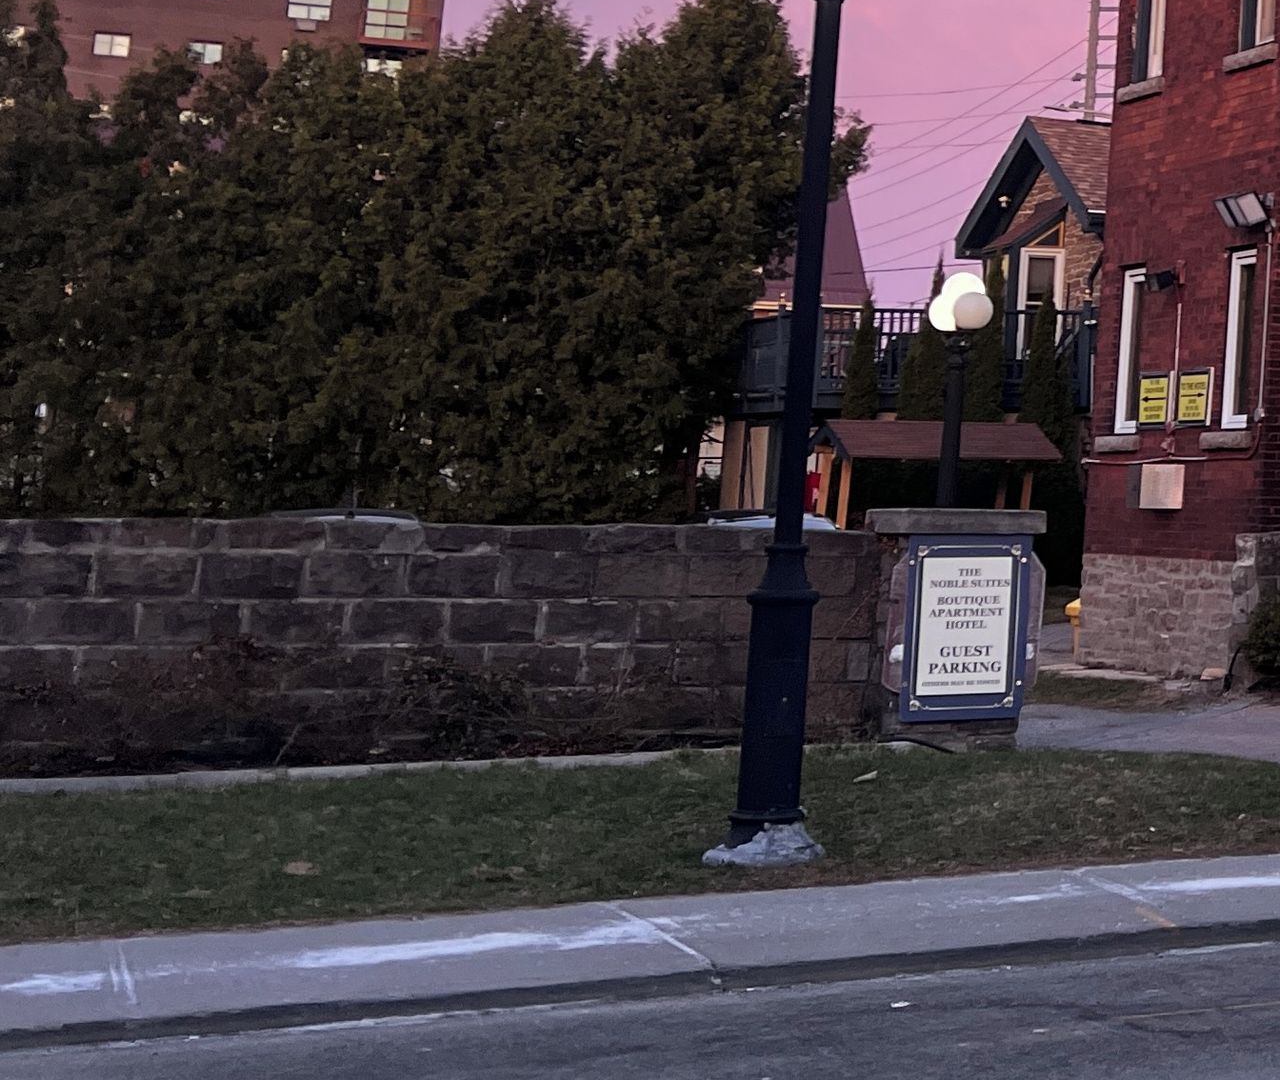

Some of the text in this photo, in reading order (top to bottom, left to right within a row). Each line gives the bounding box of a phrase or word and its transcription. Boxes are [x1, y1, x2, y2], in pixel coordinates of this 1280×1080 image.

[958, 568, 982, 577] THE
[929, 579, 1010, 589] NOBLE SUITES
[937, 595, 1000, 606] BOUTIQUE
[928, 608, 1005, 618] APARTMENT
[945, 620, 988, 629] HOTEL
[940, 645, 994, 658] GUEST
[928, 661, 1002, 674] PARKING
